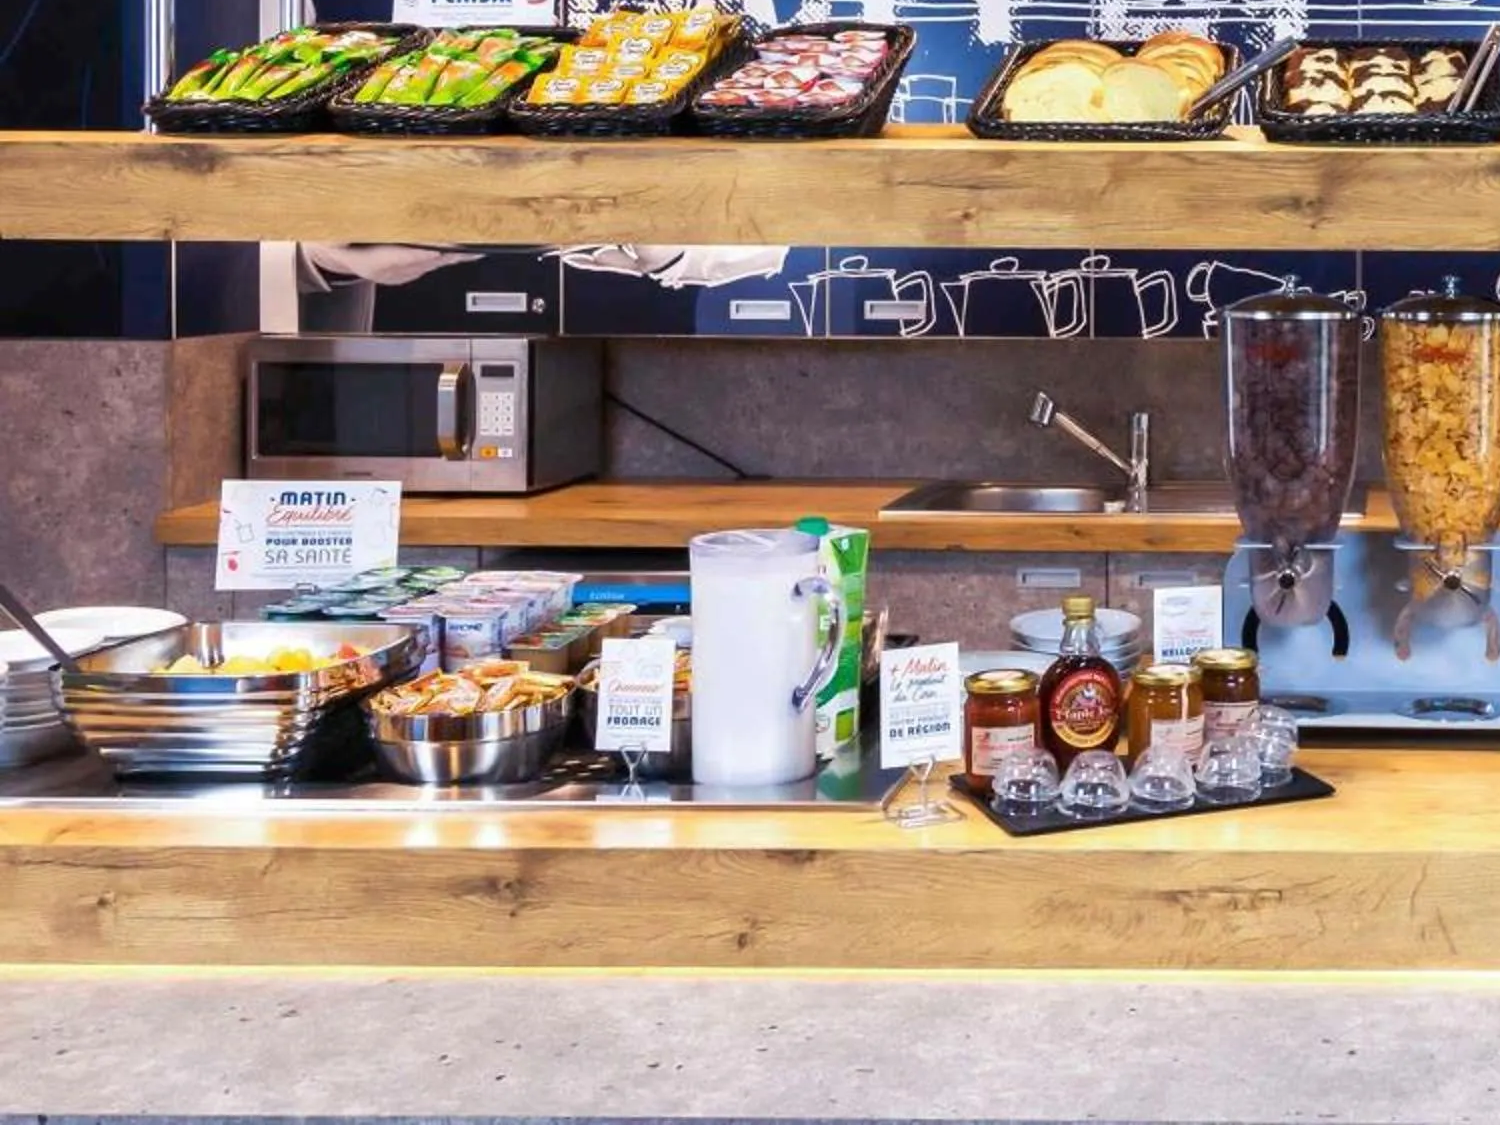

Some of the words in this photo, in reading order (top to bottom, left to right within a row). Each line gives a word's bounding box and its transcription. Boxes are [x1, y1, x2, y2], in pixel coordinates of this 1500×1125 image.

[280, 491, 346, 506] MATIN
[265, 548, 288, 564] SA
[295, 546, 352, 564] SANTÉ
[606, 716, 662, 727] FROMAGE
[889, 727, 903, 739] DE
